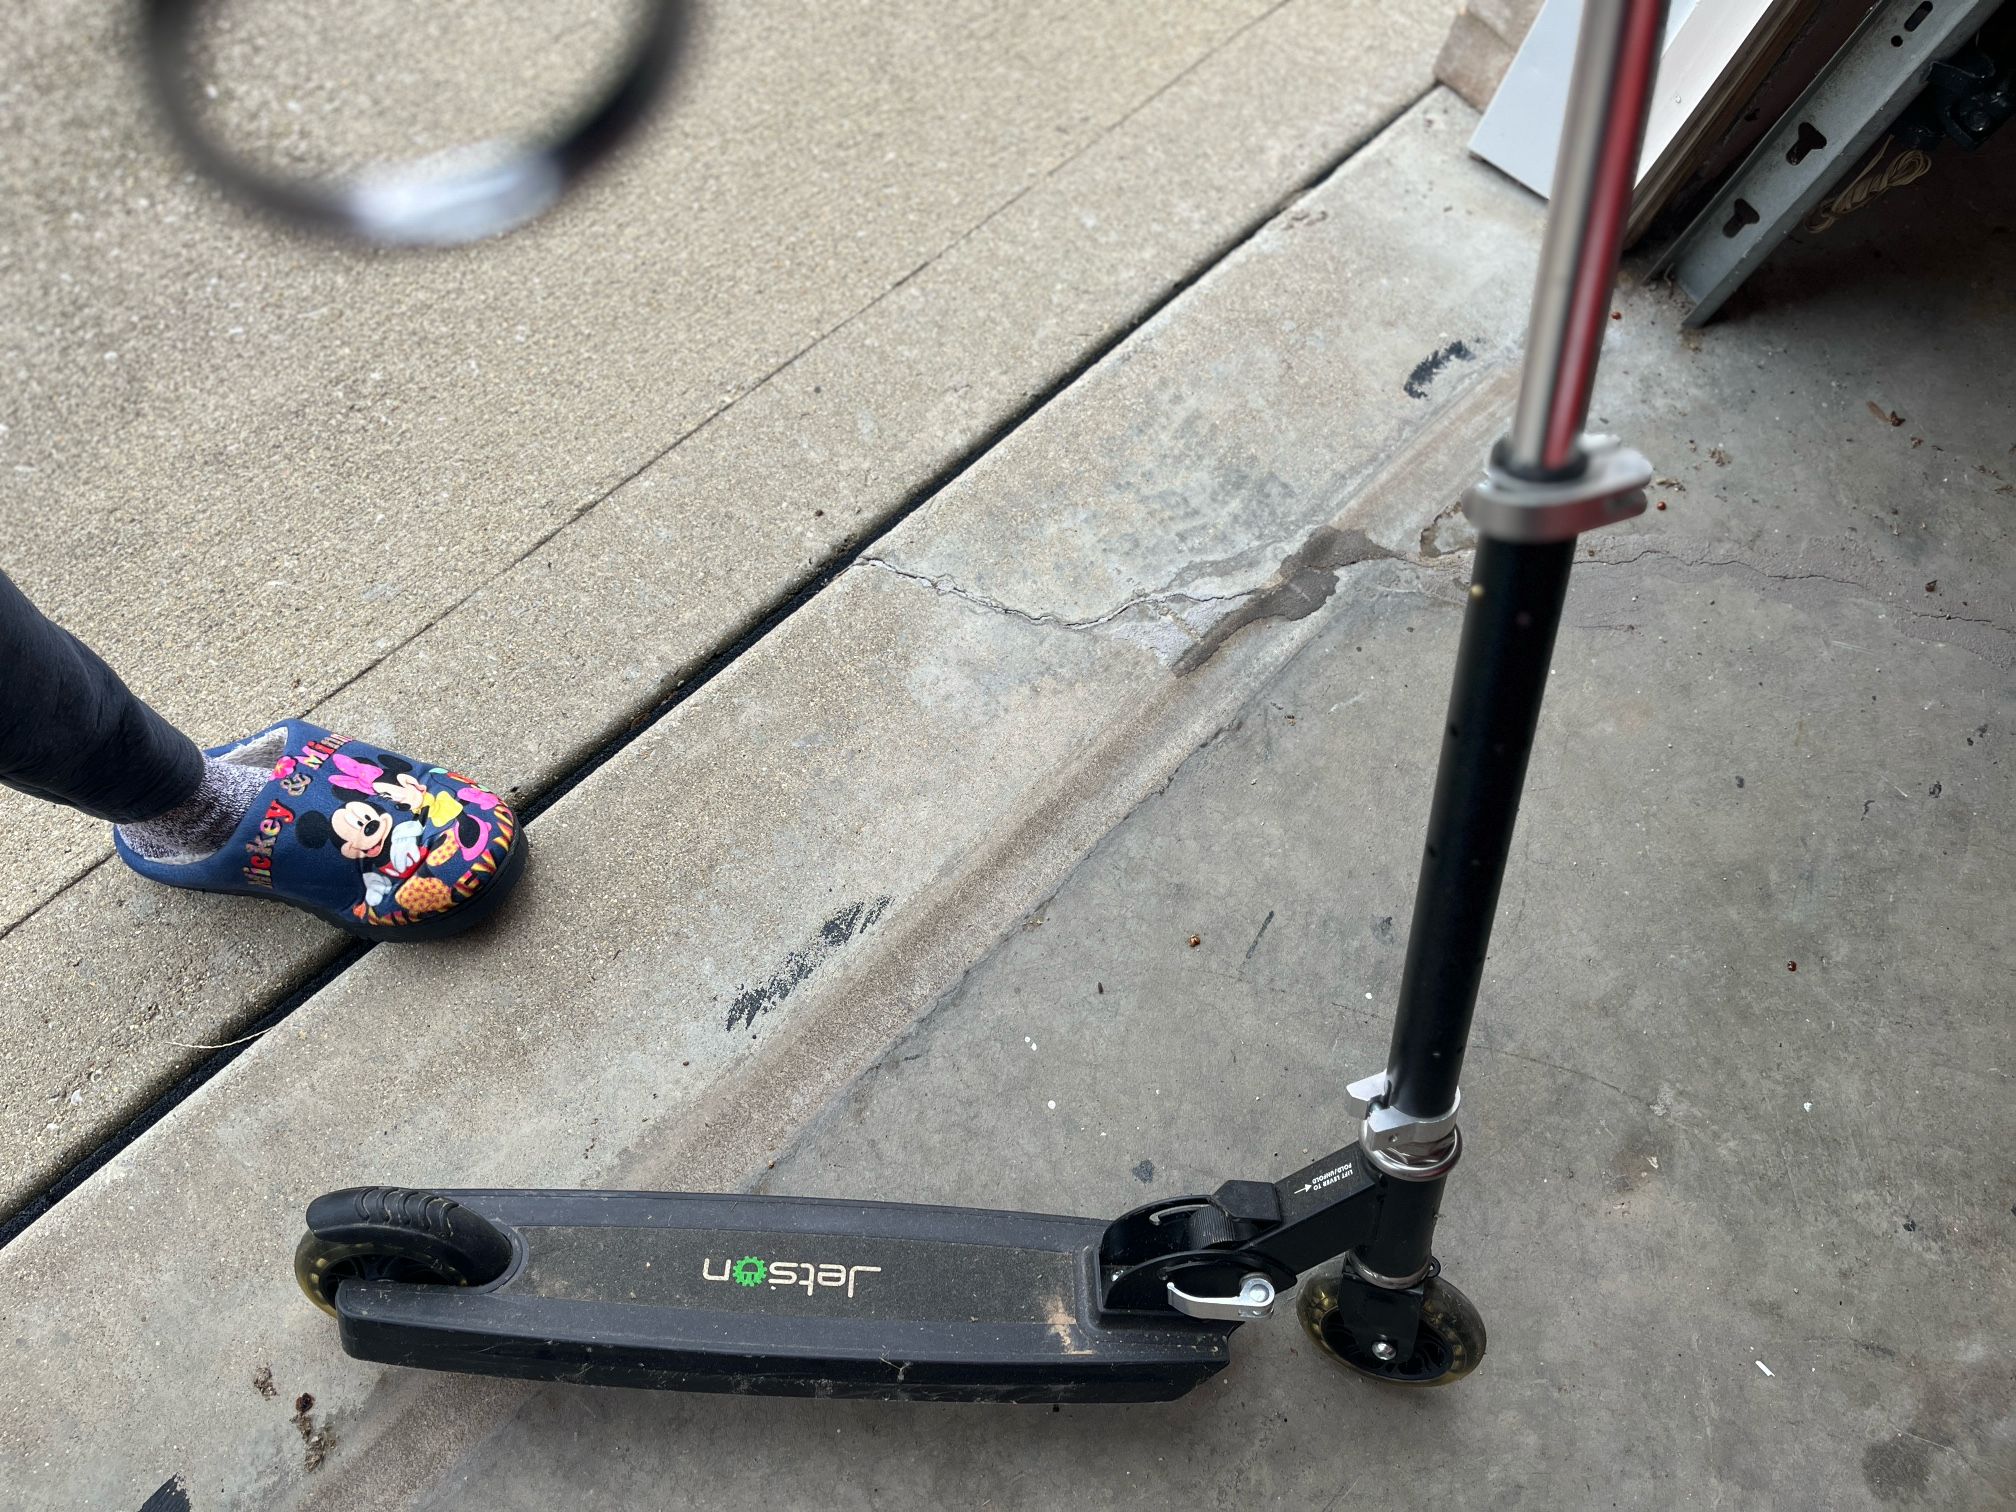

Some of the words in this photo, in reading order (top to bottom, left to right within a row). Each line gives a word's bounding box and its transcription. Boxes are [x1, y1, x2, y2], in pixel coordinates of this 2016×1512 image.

[280, 773, 313, 797] &
[1312, 1162, 1352, 1184] FOLD/UNFOLD
[1322, 1175, 1340, 1187] LEVER
[1342, 1170, 1354, 1179] LIFT
[702, 1256, 882, 1298] Jetson
